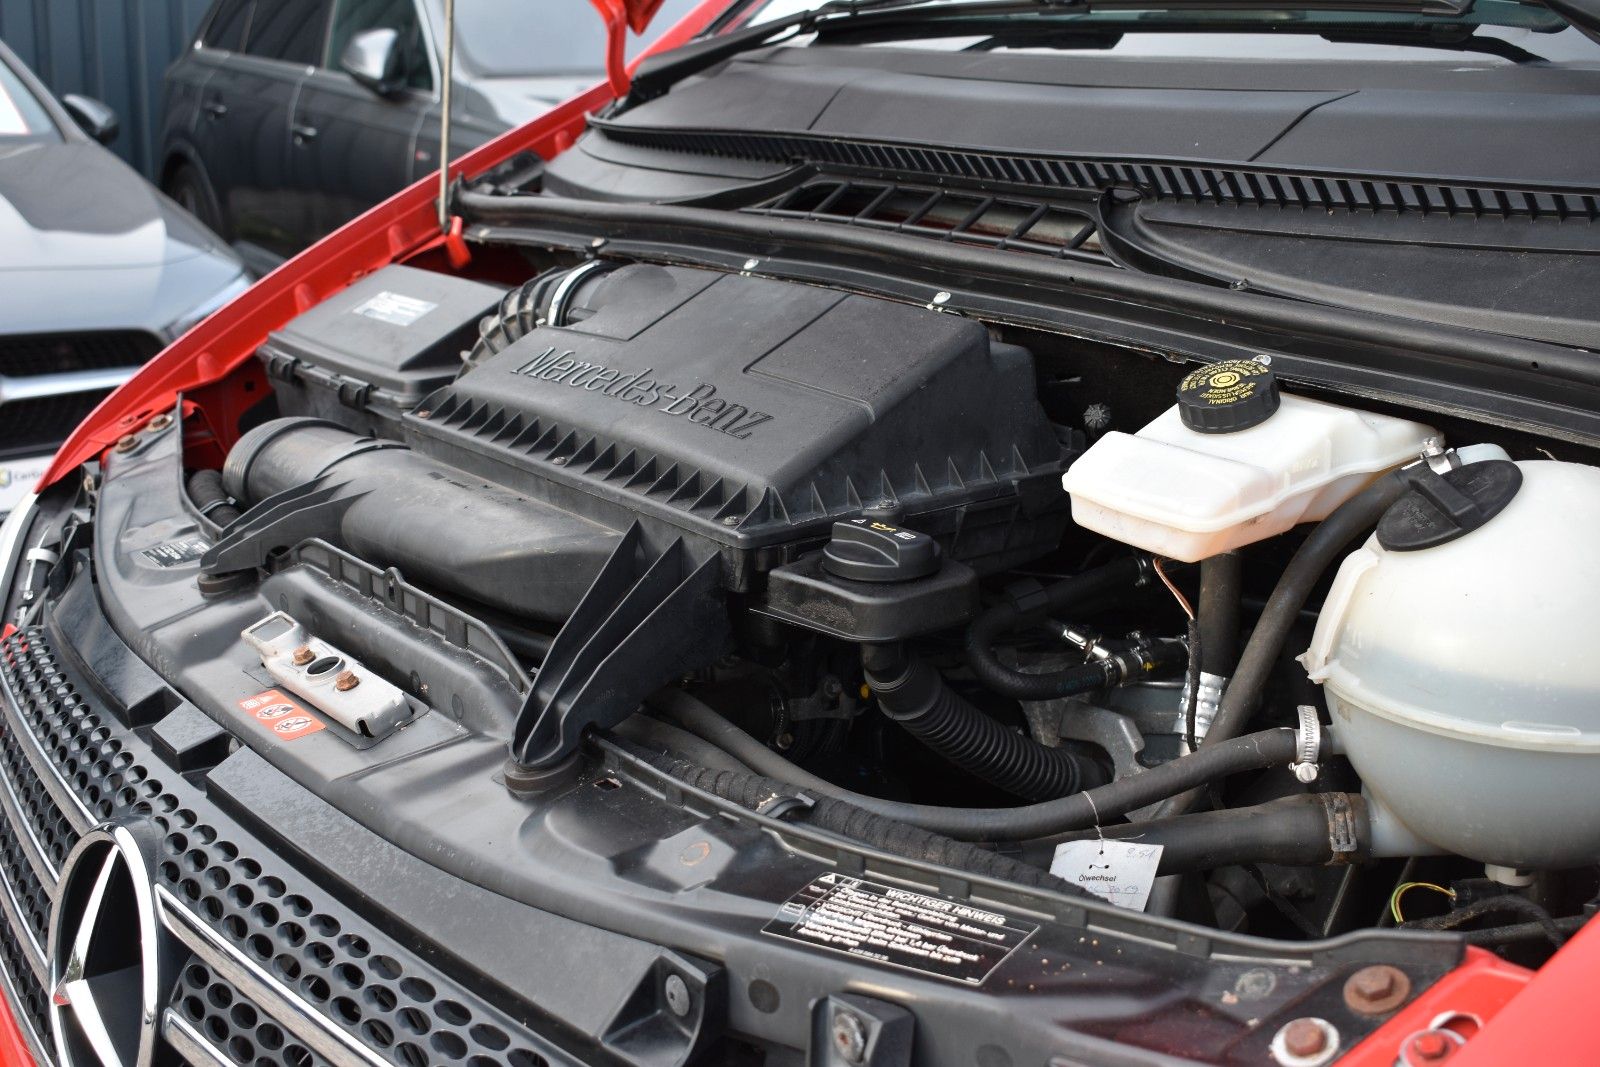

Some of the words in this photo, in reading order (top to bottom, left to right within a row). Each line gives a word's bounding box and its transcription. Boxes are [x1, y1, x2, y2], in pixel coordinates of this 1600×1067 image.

[509, 346, 774, 440] Mercedes-Benz
[886, 889, 952, 911] WICHTIGER
[952, 907, 1006, 925] HINWEIS
